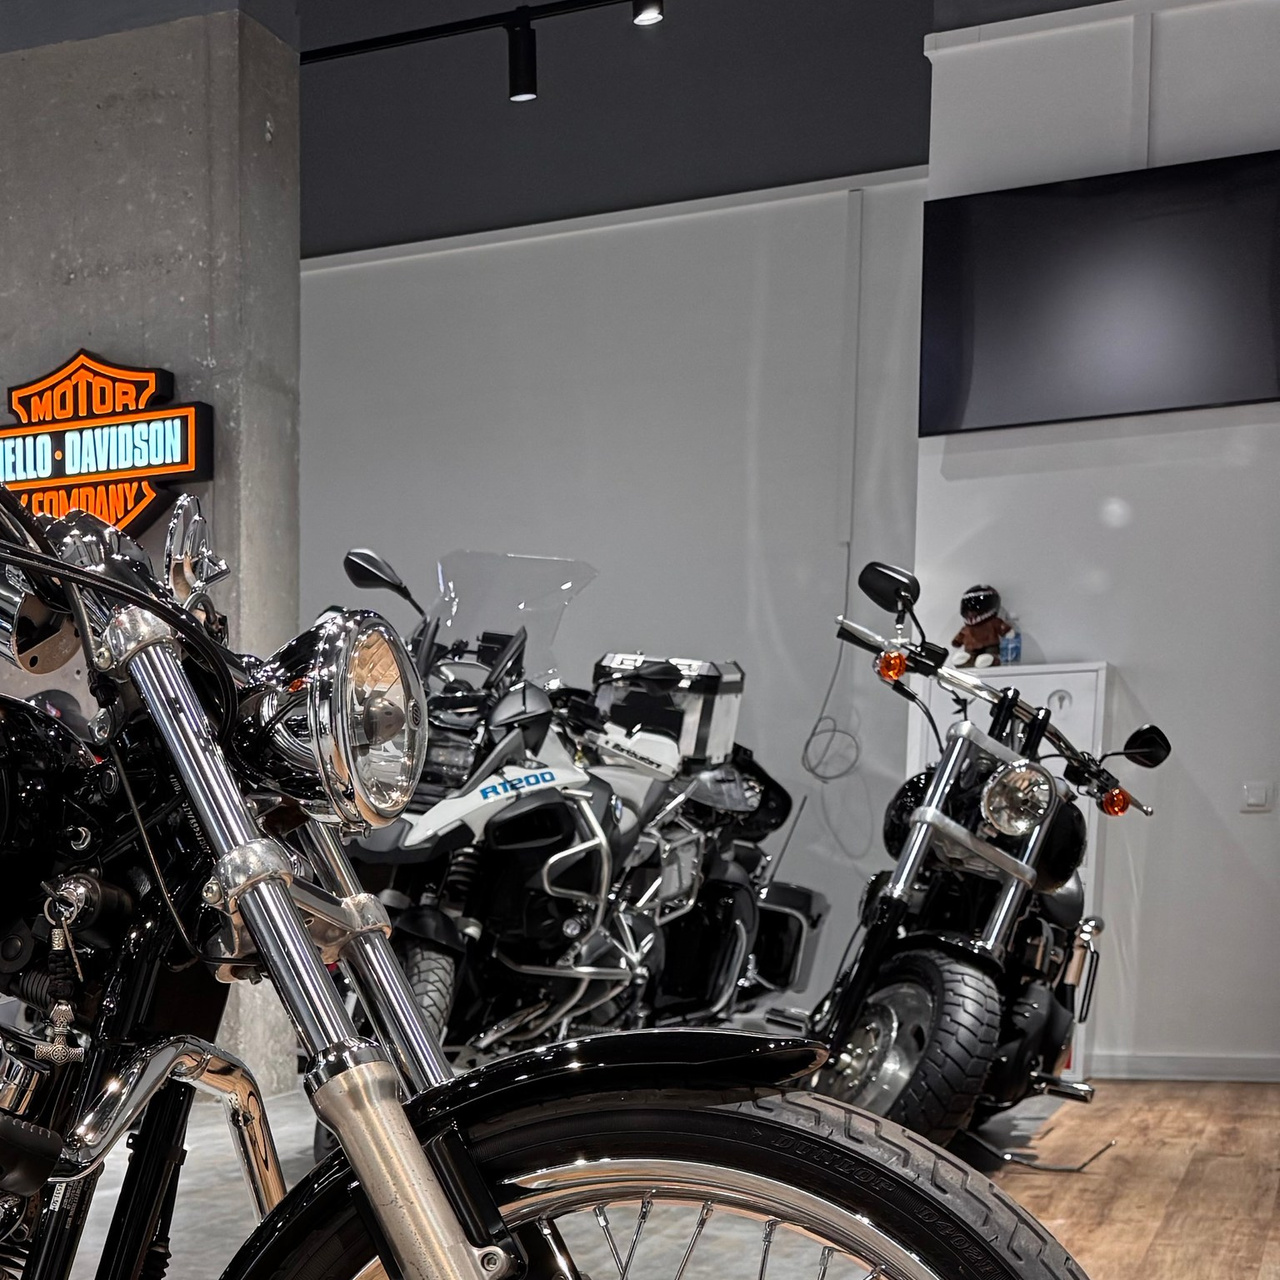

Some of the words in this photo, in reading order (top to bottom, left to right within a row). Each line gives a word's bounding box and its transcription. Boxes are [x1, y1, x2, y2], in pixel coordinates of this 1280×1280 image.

[31, 368, 136, 422] MOTOR
[65, 418, 181, 475] DAVIDSON
[480, 771, 555, 800] R1200
[772, 1133, 897, 1193] DUNLOP
